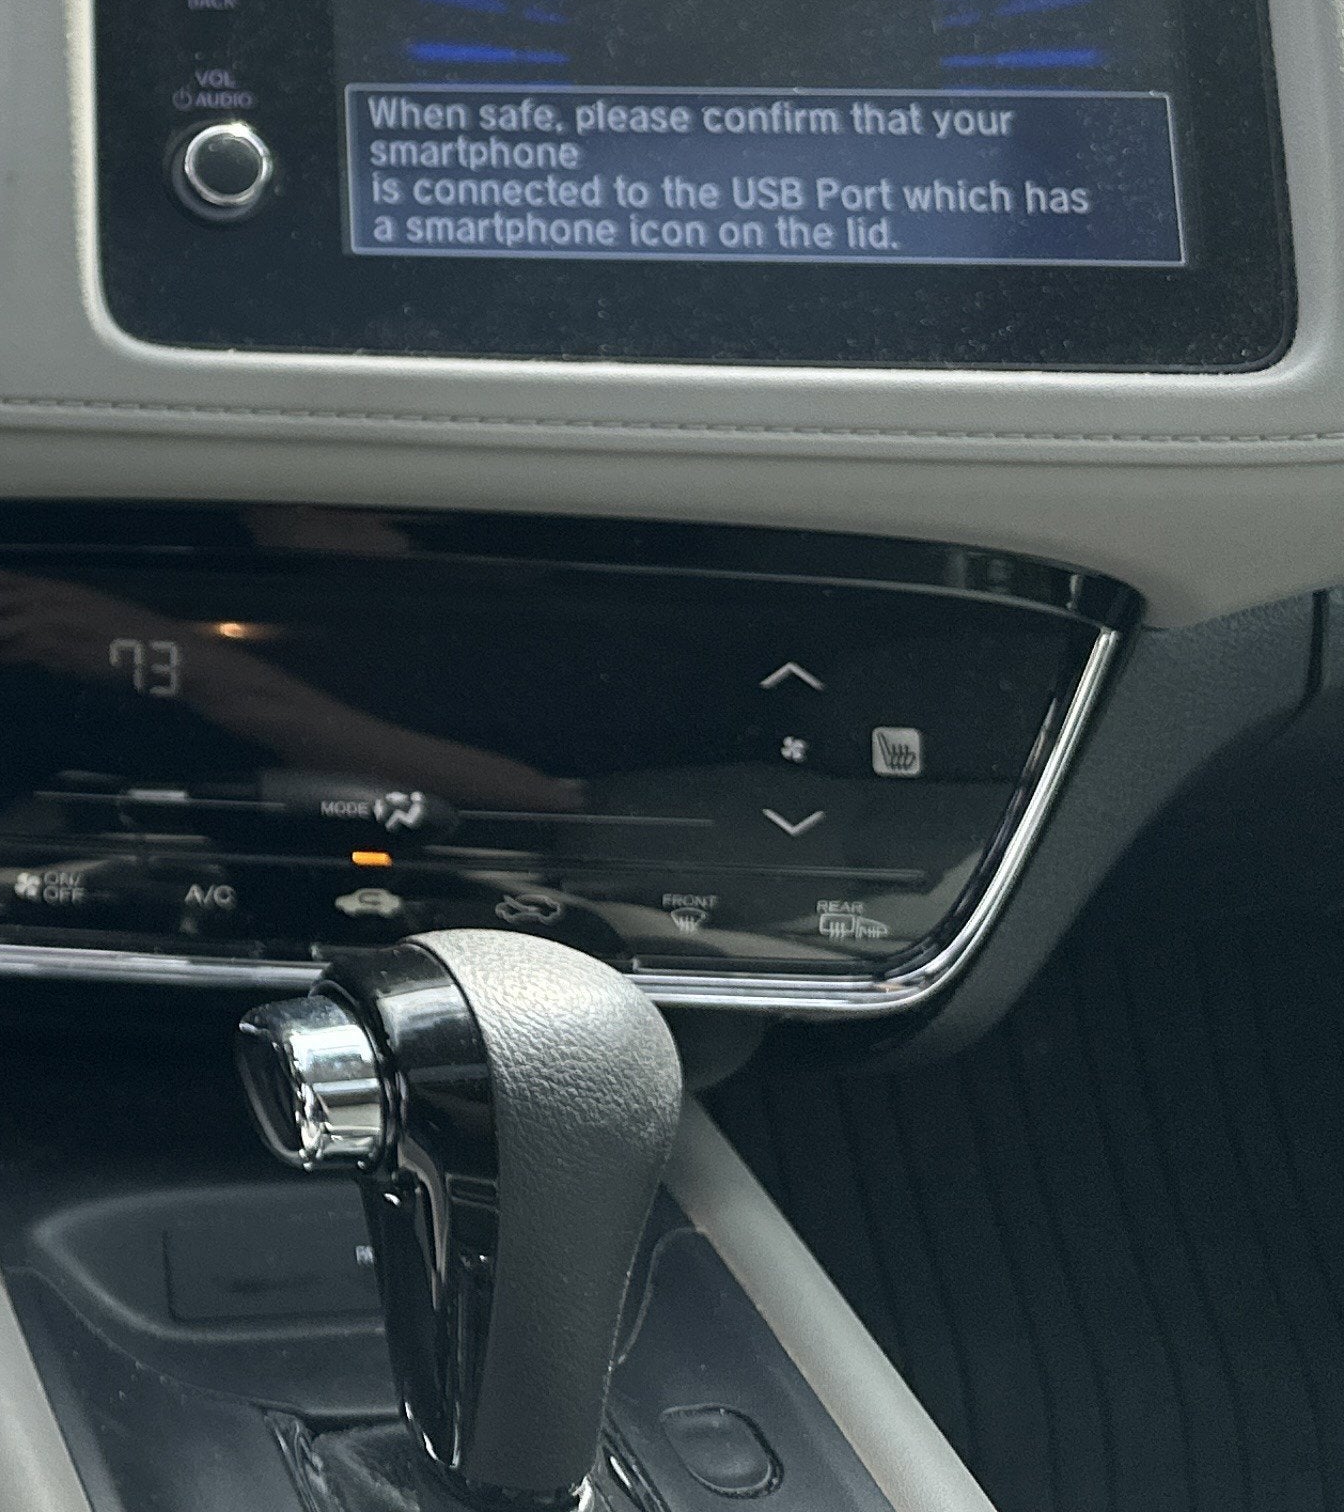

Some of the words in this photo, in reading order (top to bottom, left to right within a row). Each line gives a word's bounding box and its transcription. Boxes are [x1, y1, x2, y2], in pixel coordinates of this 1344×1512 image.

[194, 69, 237, 88] VOL
[195, 91, 254, 107] AUDIO
[367, 96, 467, 131] When
[479, 98, 566, 133] safe,
[576, 99, 692, 135] please
[703, 101, 841, 134] confirm
[850, 101, 923, 136] that
[932, 108, 1014, 140] your
[369, 136, 580, 171] smartphone
[372, 172, 401, 204] is
[413, 174, 603, 207] connected
[613, 176, 651, 208] to
[662, 176, 721, 209] the
[731, 176, 805, 210] USB
[815, 178, 893, 212] Port
[902, 178, 1014, 213] which
[1024, 180, 1092, 215] has
[373, 215, 396, 243] a
[405, 212, 617, 247] smartphone
[629, 215, 708, 248] icon
[718, 221, 765, 249] on
[776, 216, 835, 249] the
[846, 217, 902, 250] lid.
[109, 639, 182, 697] 73
[321, 801, 370, 817] MODE
[43, 886, 85, 905] OFF
[184, 884, 236, 909] A/C
[662, 893, 719, 908] FRONT
[816, 900, 863, 915] REAR
